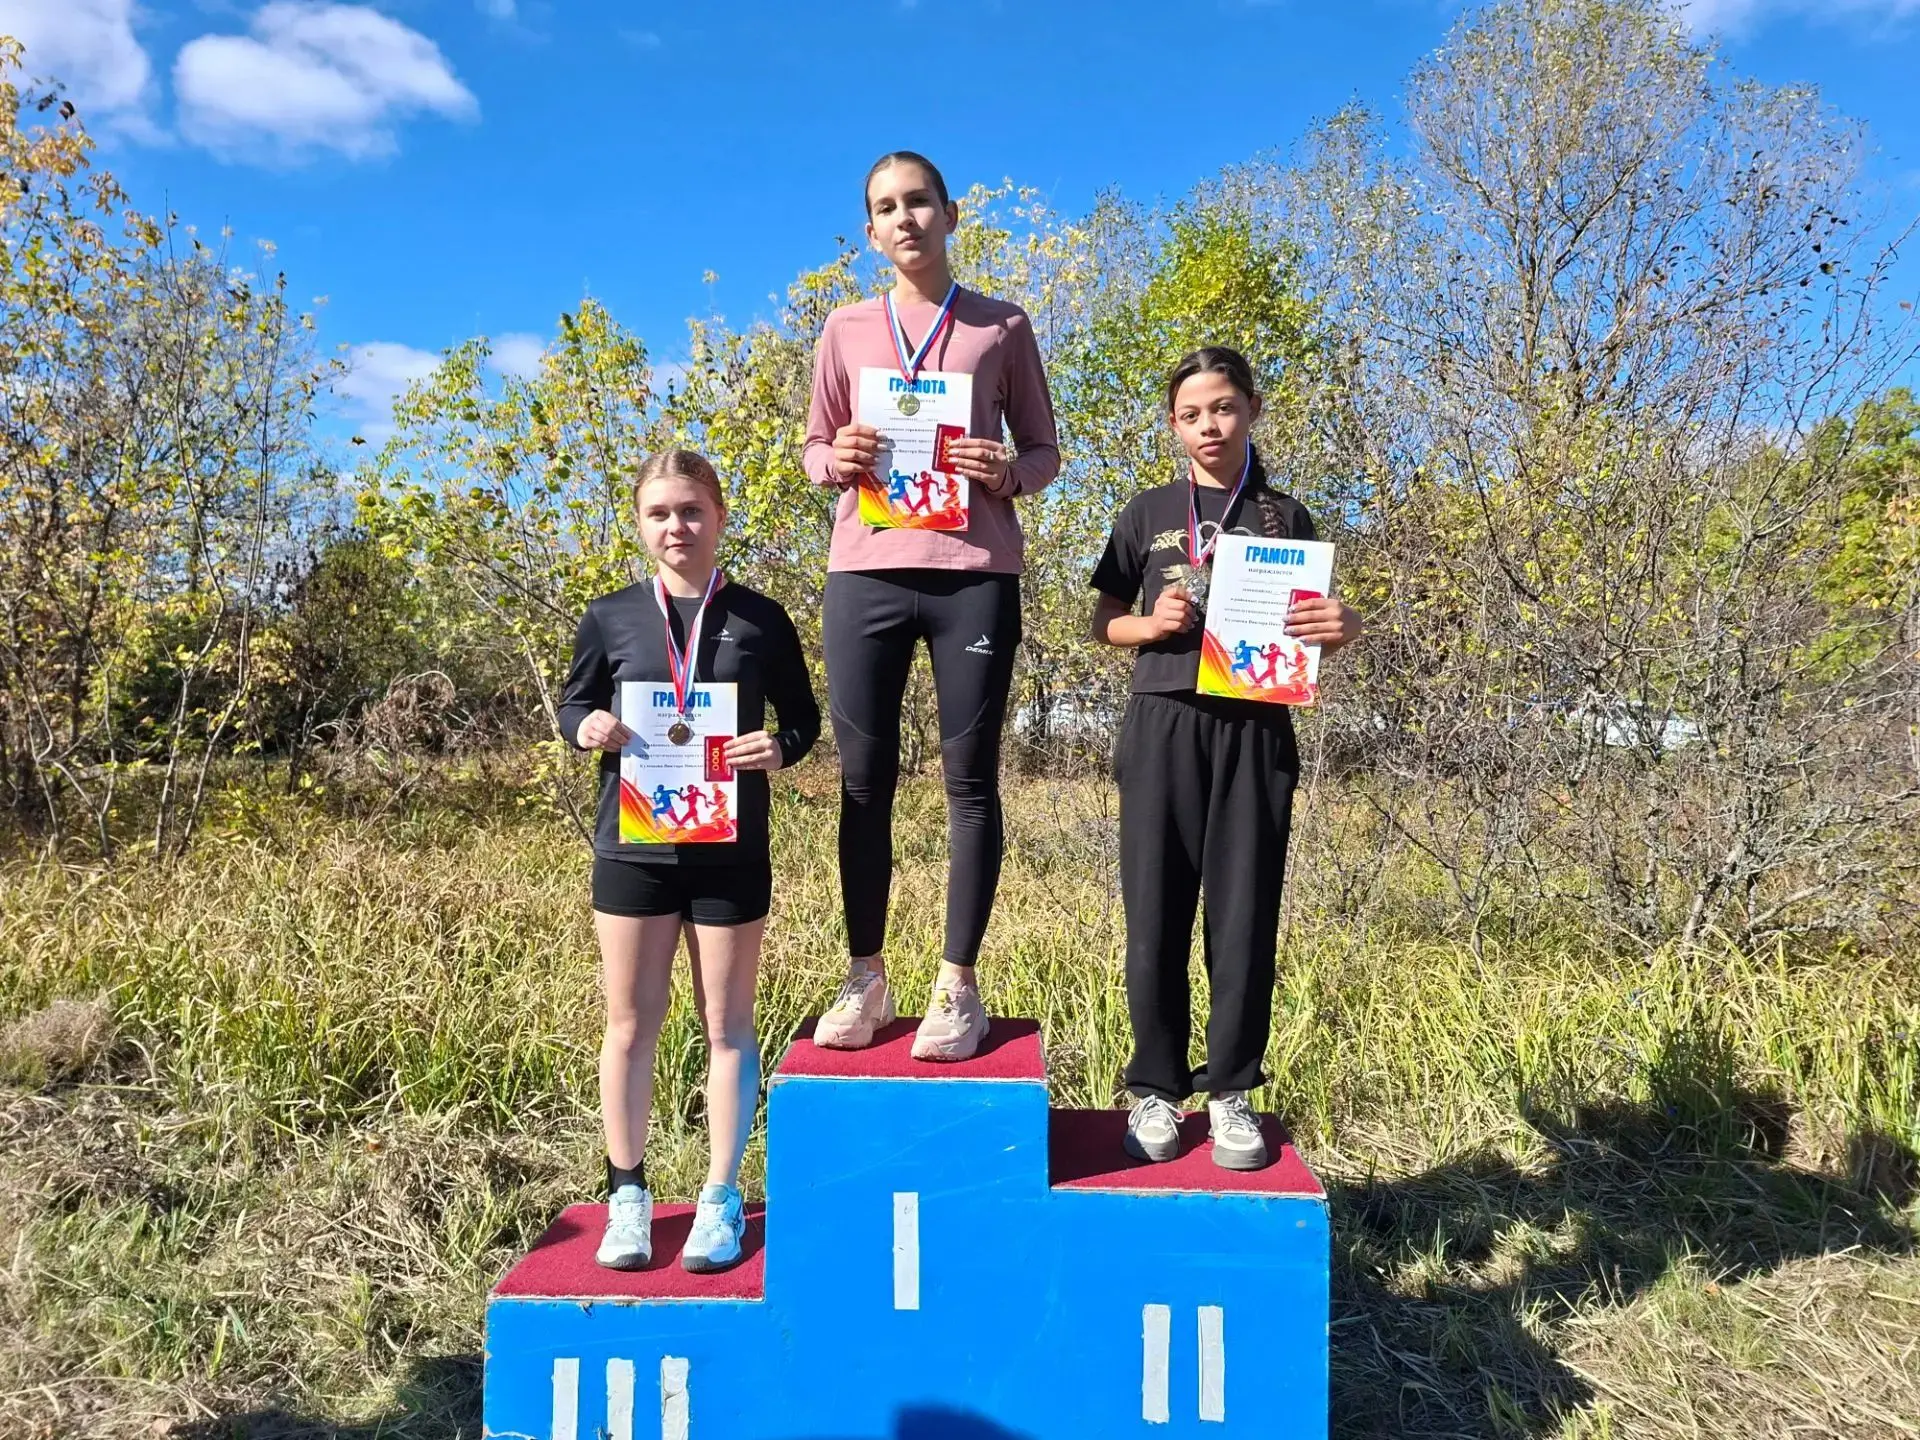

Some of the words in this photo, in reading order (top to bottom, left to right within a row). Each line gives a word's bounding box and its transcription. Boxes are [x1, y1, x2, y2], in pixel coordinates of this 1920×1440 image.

[1245, 545, 1305, 566] ГРАМОТА
[965, 646, 994, 656] DEMIX
[653, 691, 711, 707] ГРАОТА
[712, 747, 720, 771] 1000
